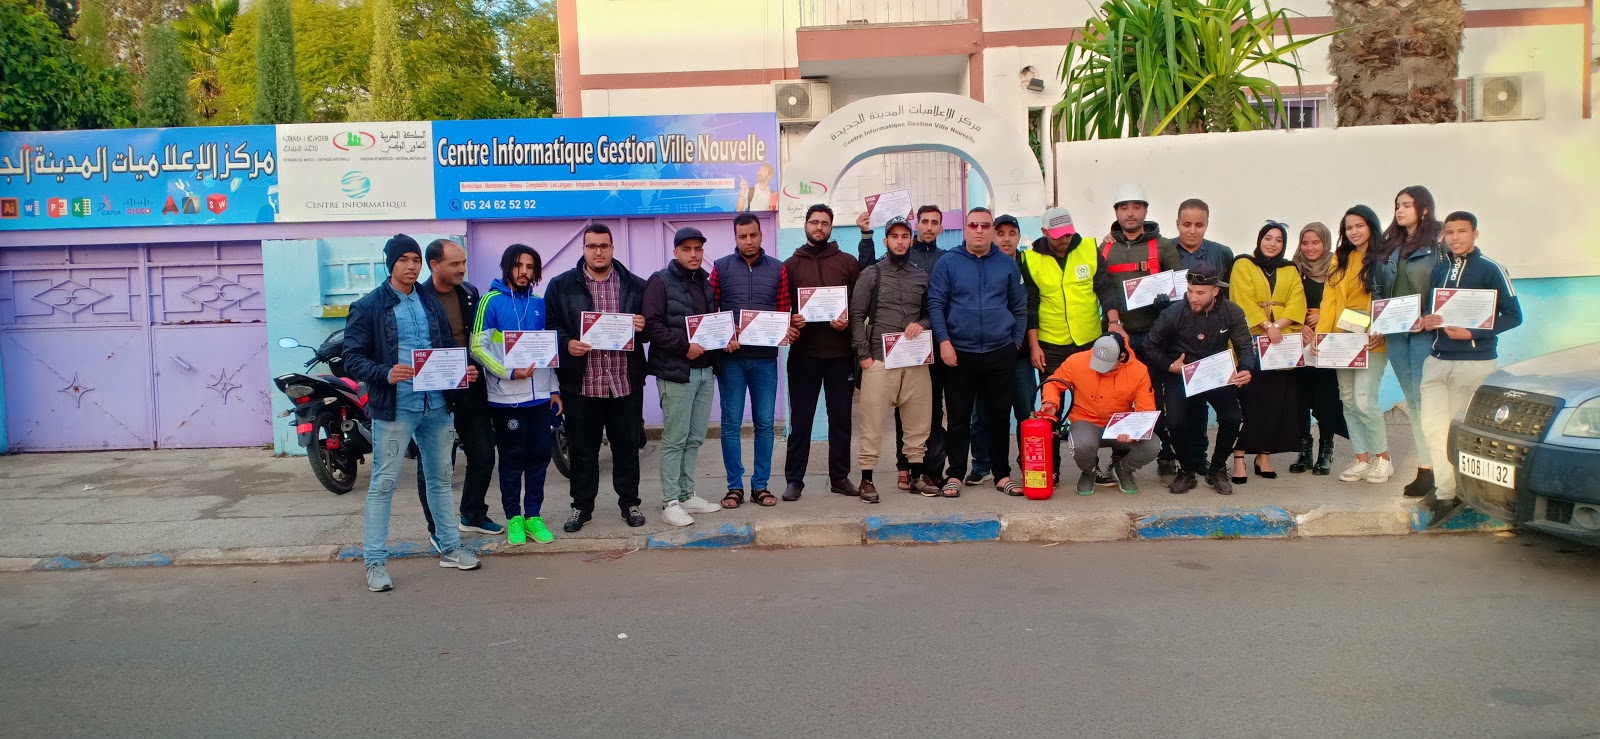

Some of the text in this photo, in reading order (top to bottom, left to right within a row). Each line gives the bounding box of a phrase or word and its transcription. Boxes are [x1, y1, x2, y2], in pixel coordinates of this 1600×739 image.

[870, 105, 904, 120] المدينة
[957, 115, 981, 132] مركز
[830, 113, 866, 140] الجديدة
[842, 134, 863, 147] Centre
[864, 122, 906, 136] Informatique
[934, 122, 948, 130] Ville
[950, 127, 976, 144] Nouvelle
[34, 144, 108, 183] المدينة
[112, 143, 218, 182] الإعلاميات
[220, 141, 275, 181] مركز
[438, 133, 766, 174] Centre Informatique Gestion Ville Nouvelle
[463, 200, 536, 210] 05 24 62 52 92
[1462, 455, 1480, 476] 5106
[1496, 466, 1508, 483] 32
